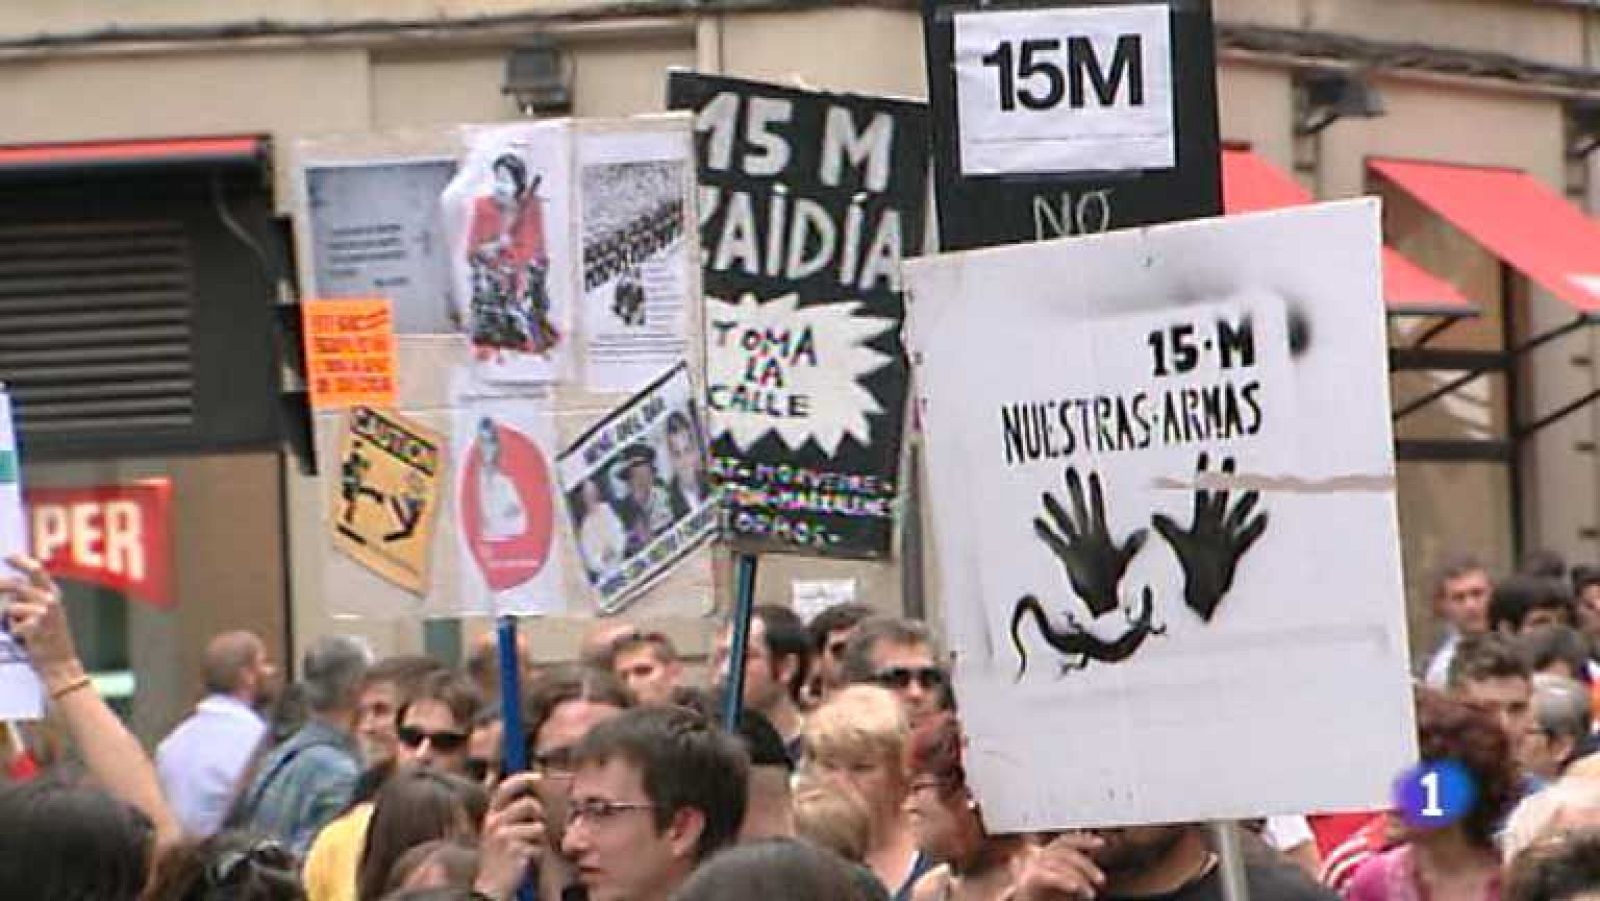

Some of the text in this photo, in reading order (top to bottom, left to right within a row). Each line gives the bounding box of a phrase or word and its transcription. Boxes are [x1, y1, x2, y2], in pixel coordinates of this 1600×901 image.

[982, 33, 1144, 112] 15M
[696, 92, 893, 193] 15 M
[711, 320, 817, 367] TOMA
[744, 357, 785, 389] LA
[707, 383, 809, 418] CALLE
[33, 502, 145, 582] PER
